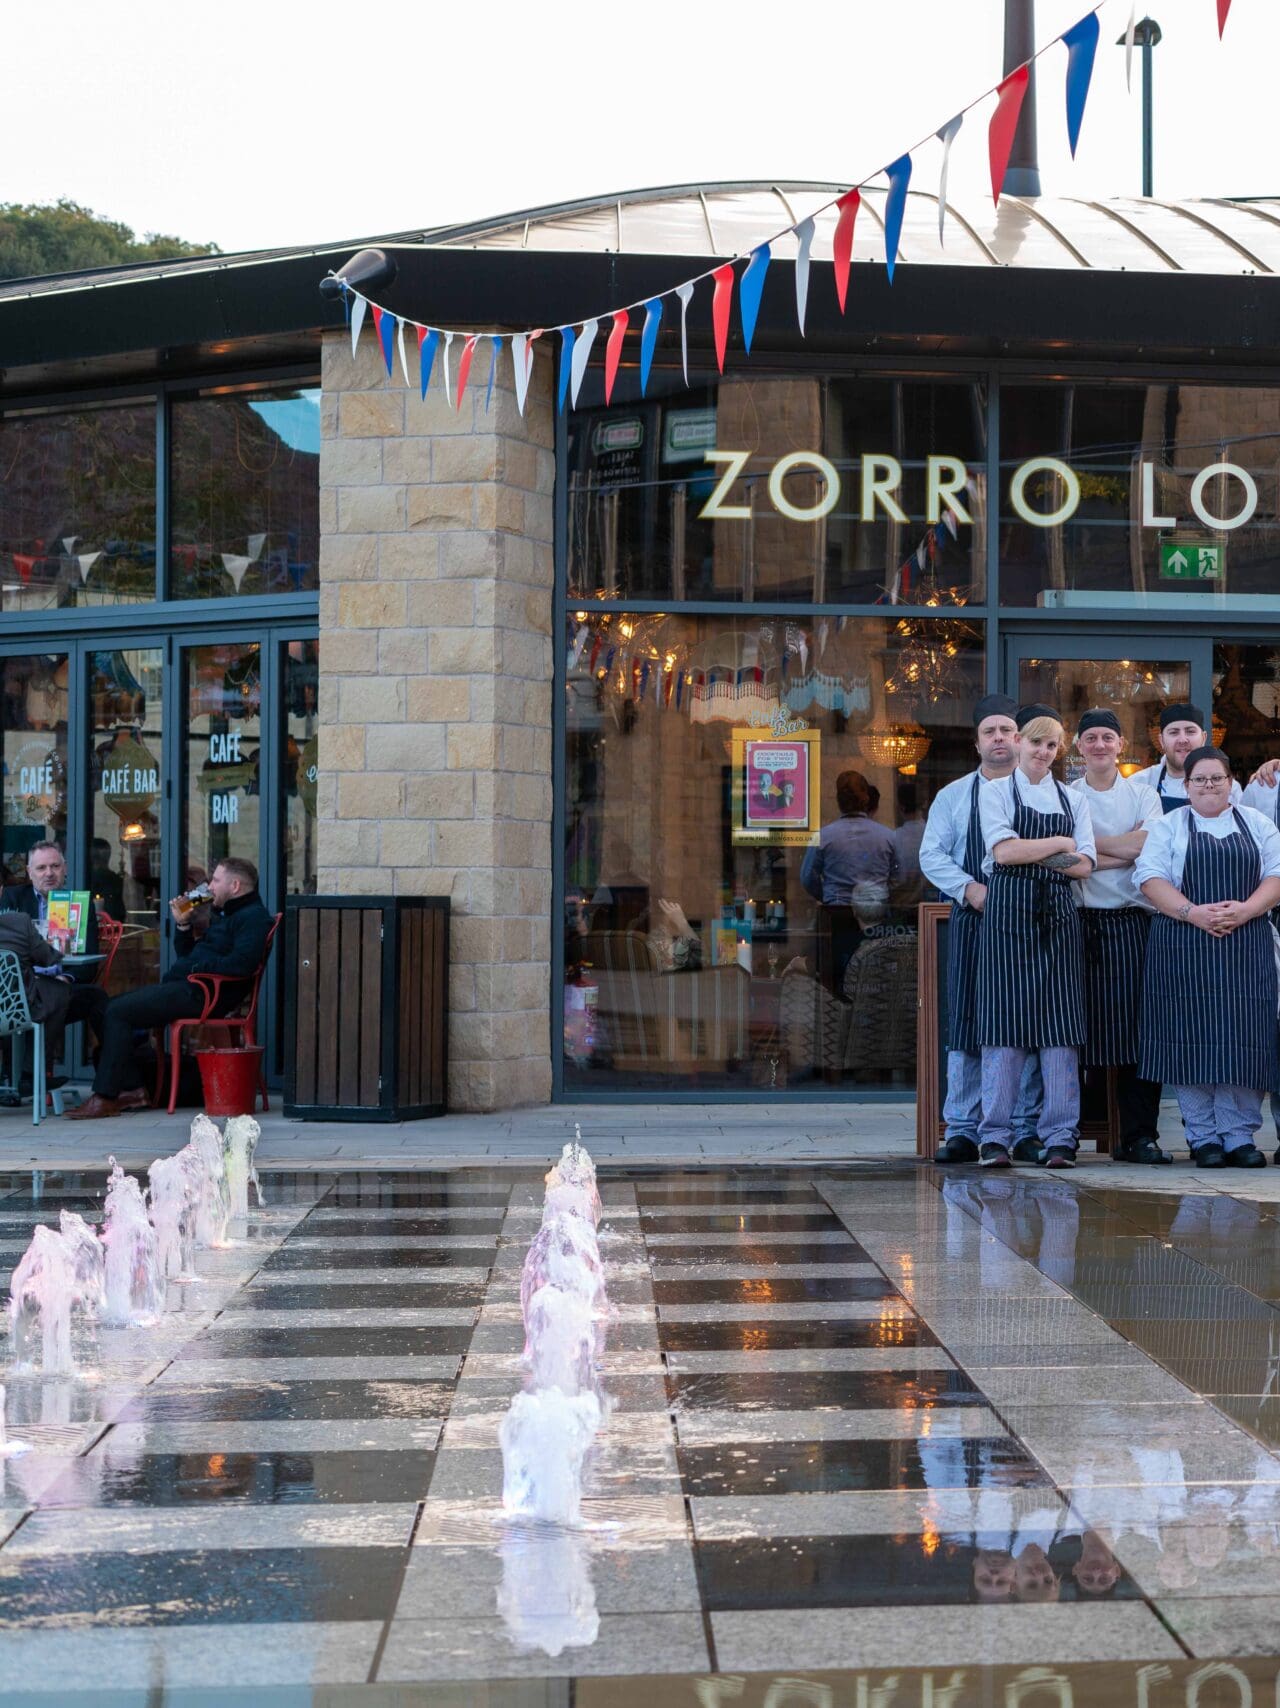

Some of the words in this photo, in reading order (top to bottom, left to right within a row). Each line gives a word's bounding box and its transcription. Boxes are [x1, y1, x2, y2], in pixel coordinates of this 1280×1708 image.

[698, 449, 1082, 527] ZORRO
[750, 703, 791, 728] Café
[771, 716, 809, 737] Bar
[210, 727, 242, 763] CAFÉ
[20, 758, 53, 795] CAFÉ
[102, 763, 130, 794] CAFÉ
[134, 768, 158, 794] BAR
[212, 795, 239, 823] BAR
